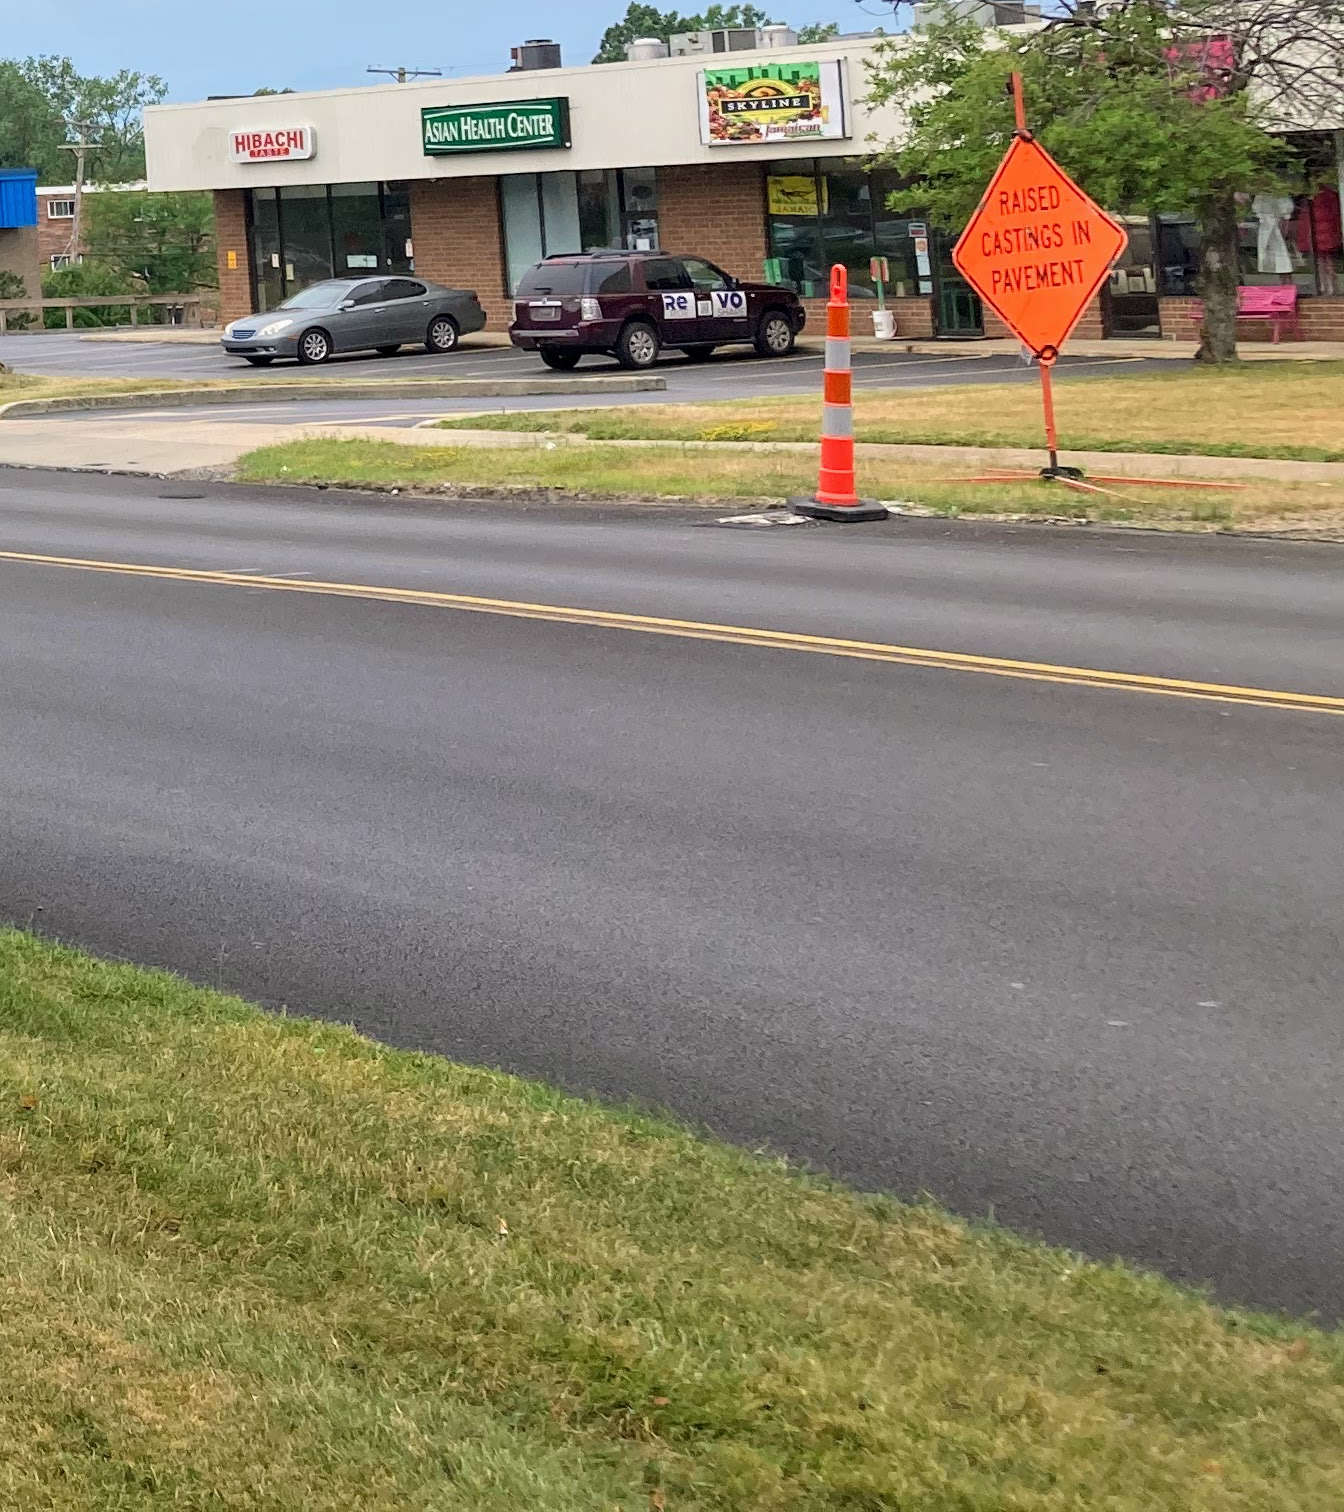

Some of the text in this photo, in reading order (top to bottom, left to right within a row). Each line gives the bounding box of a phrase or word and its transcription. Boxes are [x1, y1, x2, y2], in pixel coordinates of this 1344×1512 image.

[727, 97, 802, 111] SKYLINE
[234, 130, 304, 155] HIBACHI
[424, 112, 554, 143] ASIAN HEALTH CENTER
[253, 148, 287, 157] TASTE
[999, 185, 1061, 217] RAISED
[981, 220, 1091, 257] CASTINGS IN
[991, 259, 1085, 295] PAVEMENT
